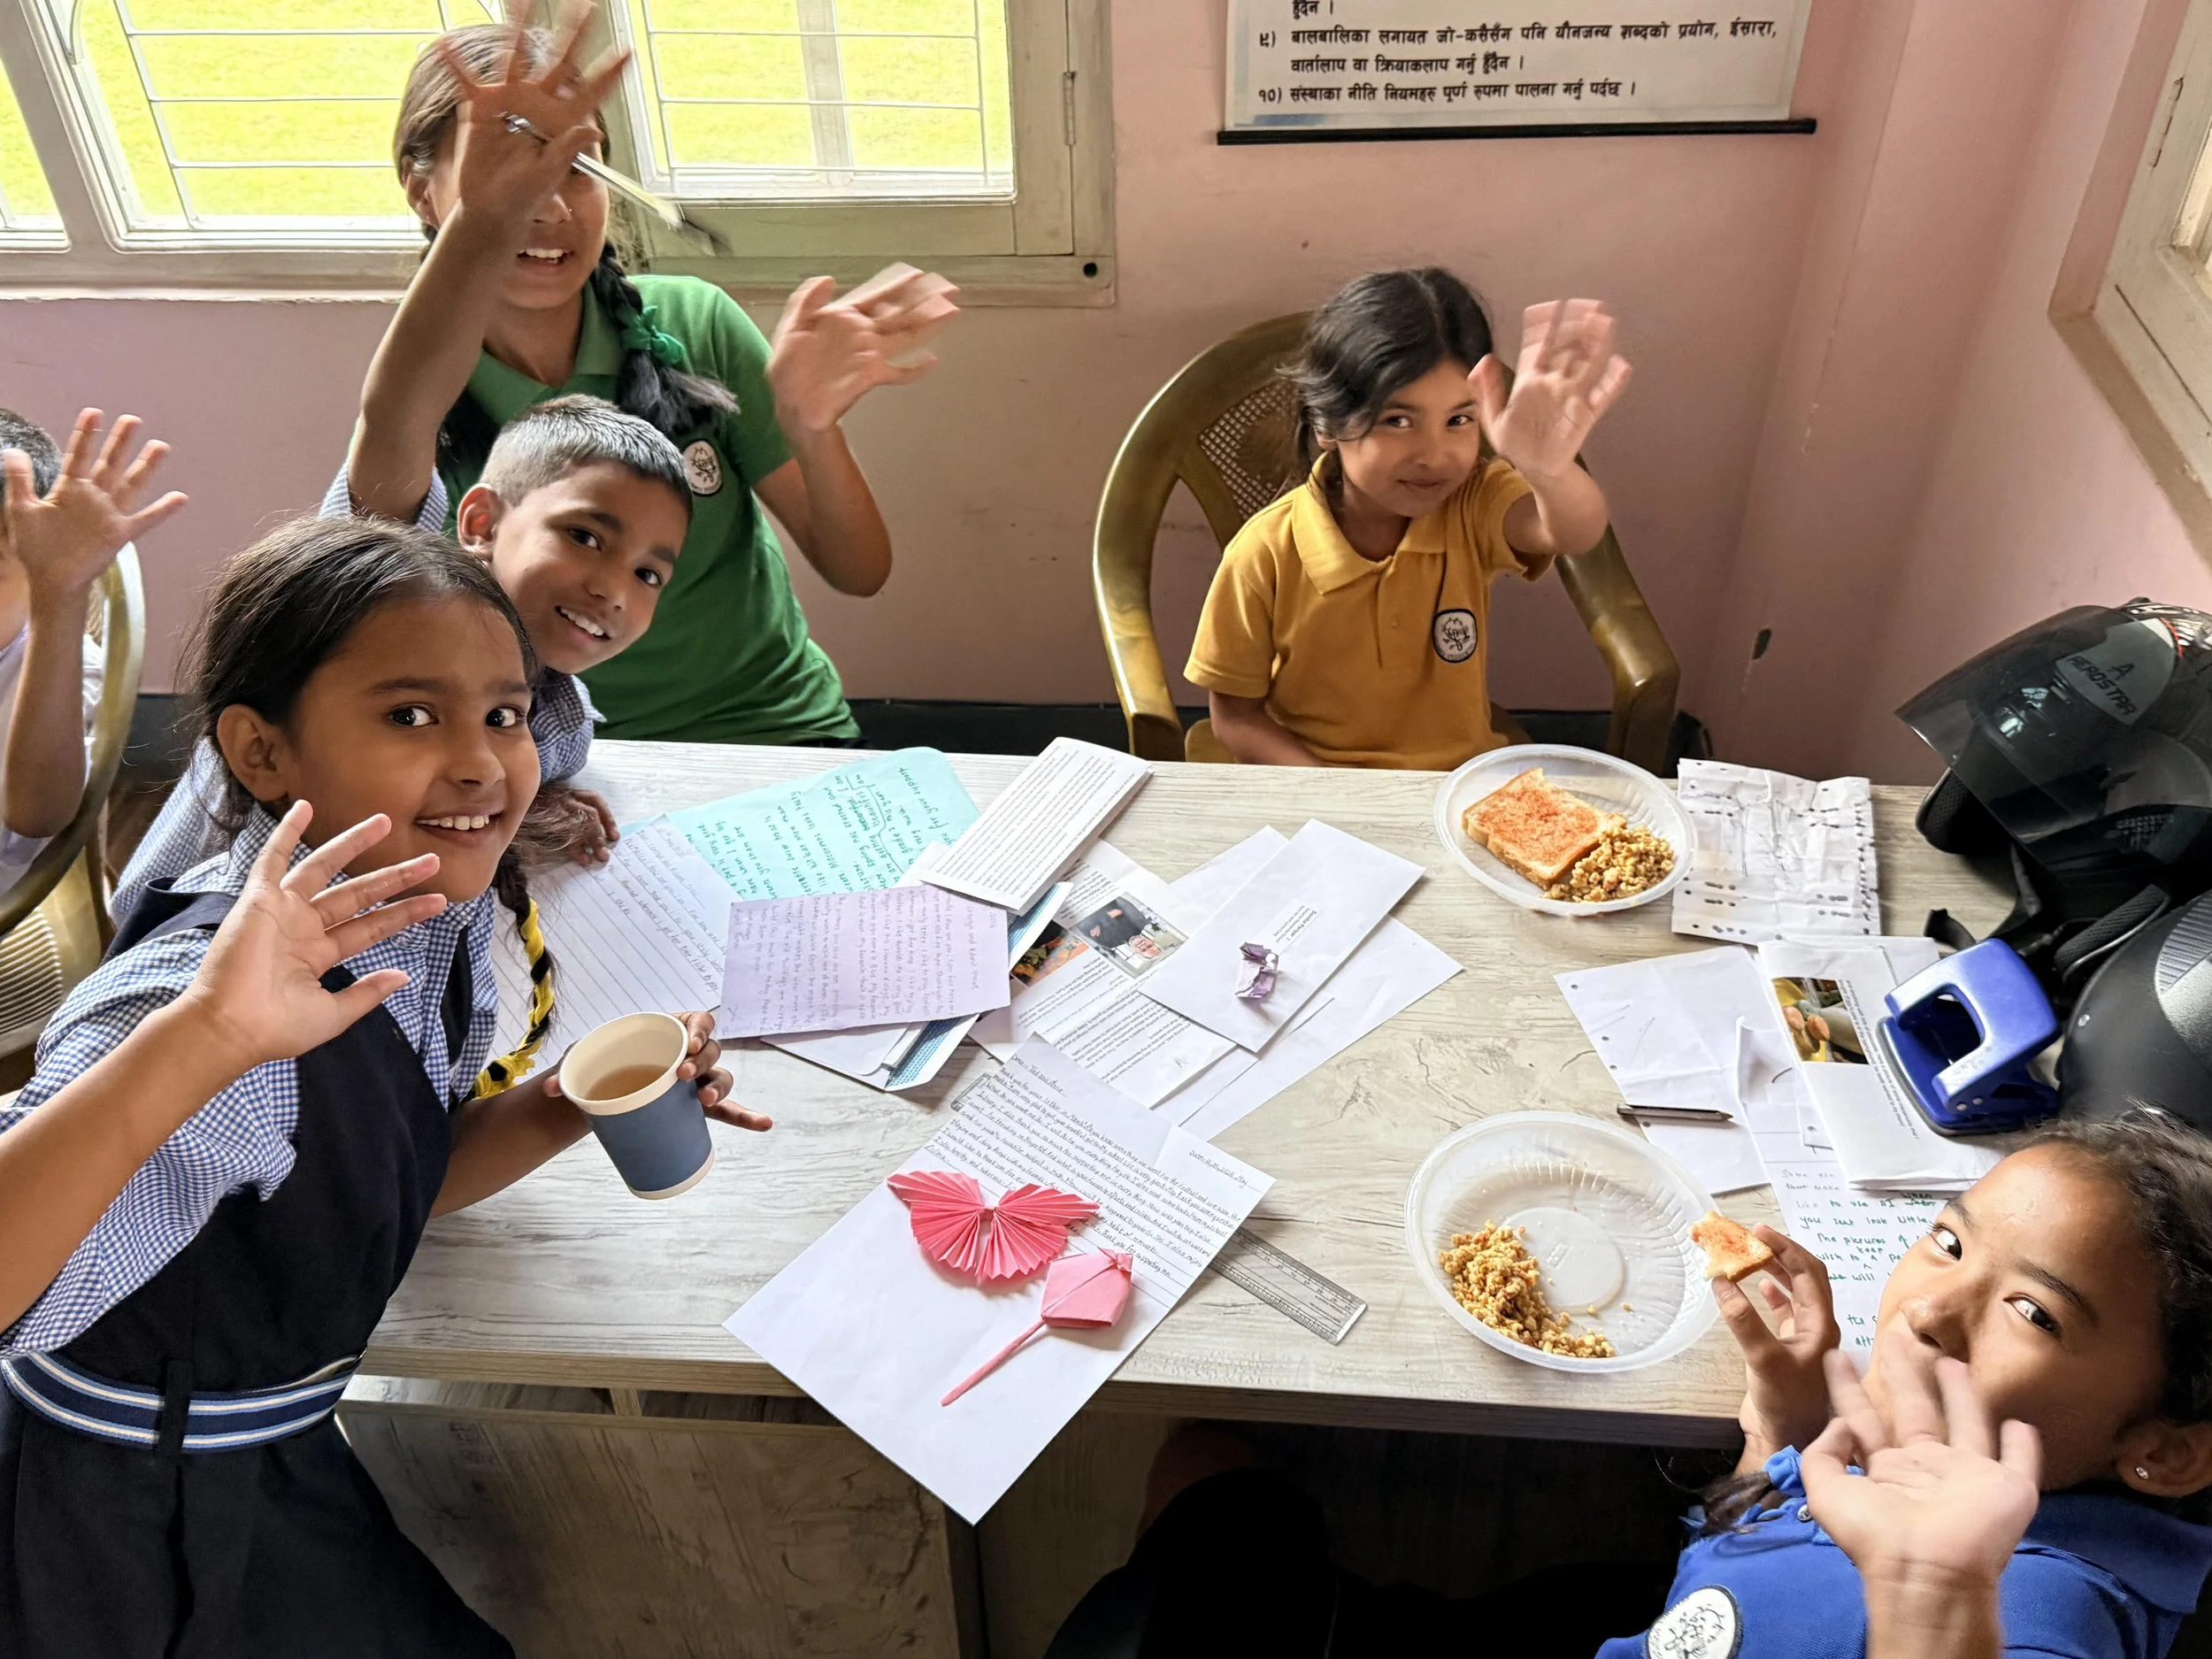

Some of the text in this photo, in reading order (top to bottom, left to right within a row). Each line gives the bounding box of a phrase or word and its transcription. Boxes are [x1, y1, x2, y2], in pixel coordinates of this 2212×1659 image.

[1291, 25, 1371, 45] बालबालिका
[1379, 29, 1429, 45] लगायत
[1520, 21, 1548, 41] पनि
[1555, 19, 1613, 40] यौनजन्य
[1620, 19, 1671, 40] शब्दको
[1291, 53, 1347, 73] वार्तालाप
[1353, 58, 1369, 73] वा
[1375, 53, 1451, 74] क्रियाकलाप
[1290, 83, 1342, 103] संस्थाका
[1348, 81, 1379, 102] नीति
[1515, 81, 1558, 99] पालना
[2064, 654, 2139, 717] AEROSTAR
[918, 799, 938, 814] your
[928, 818, 949, 829] for
[892, 833, 913, 853] grade
[817, 872, 827, 887] like
[1799, 1216, 1822, 1229] you
